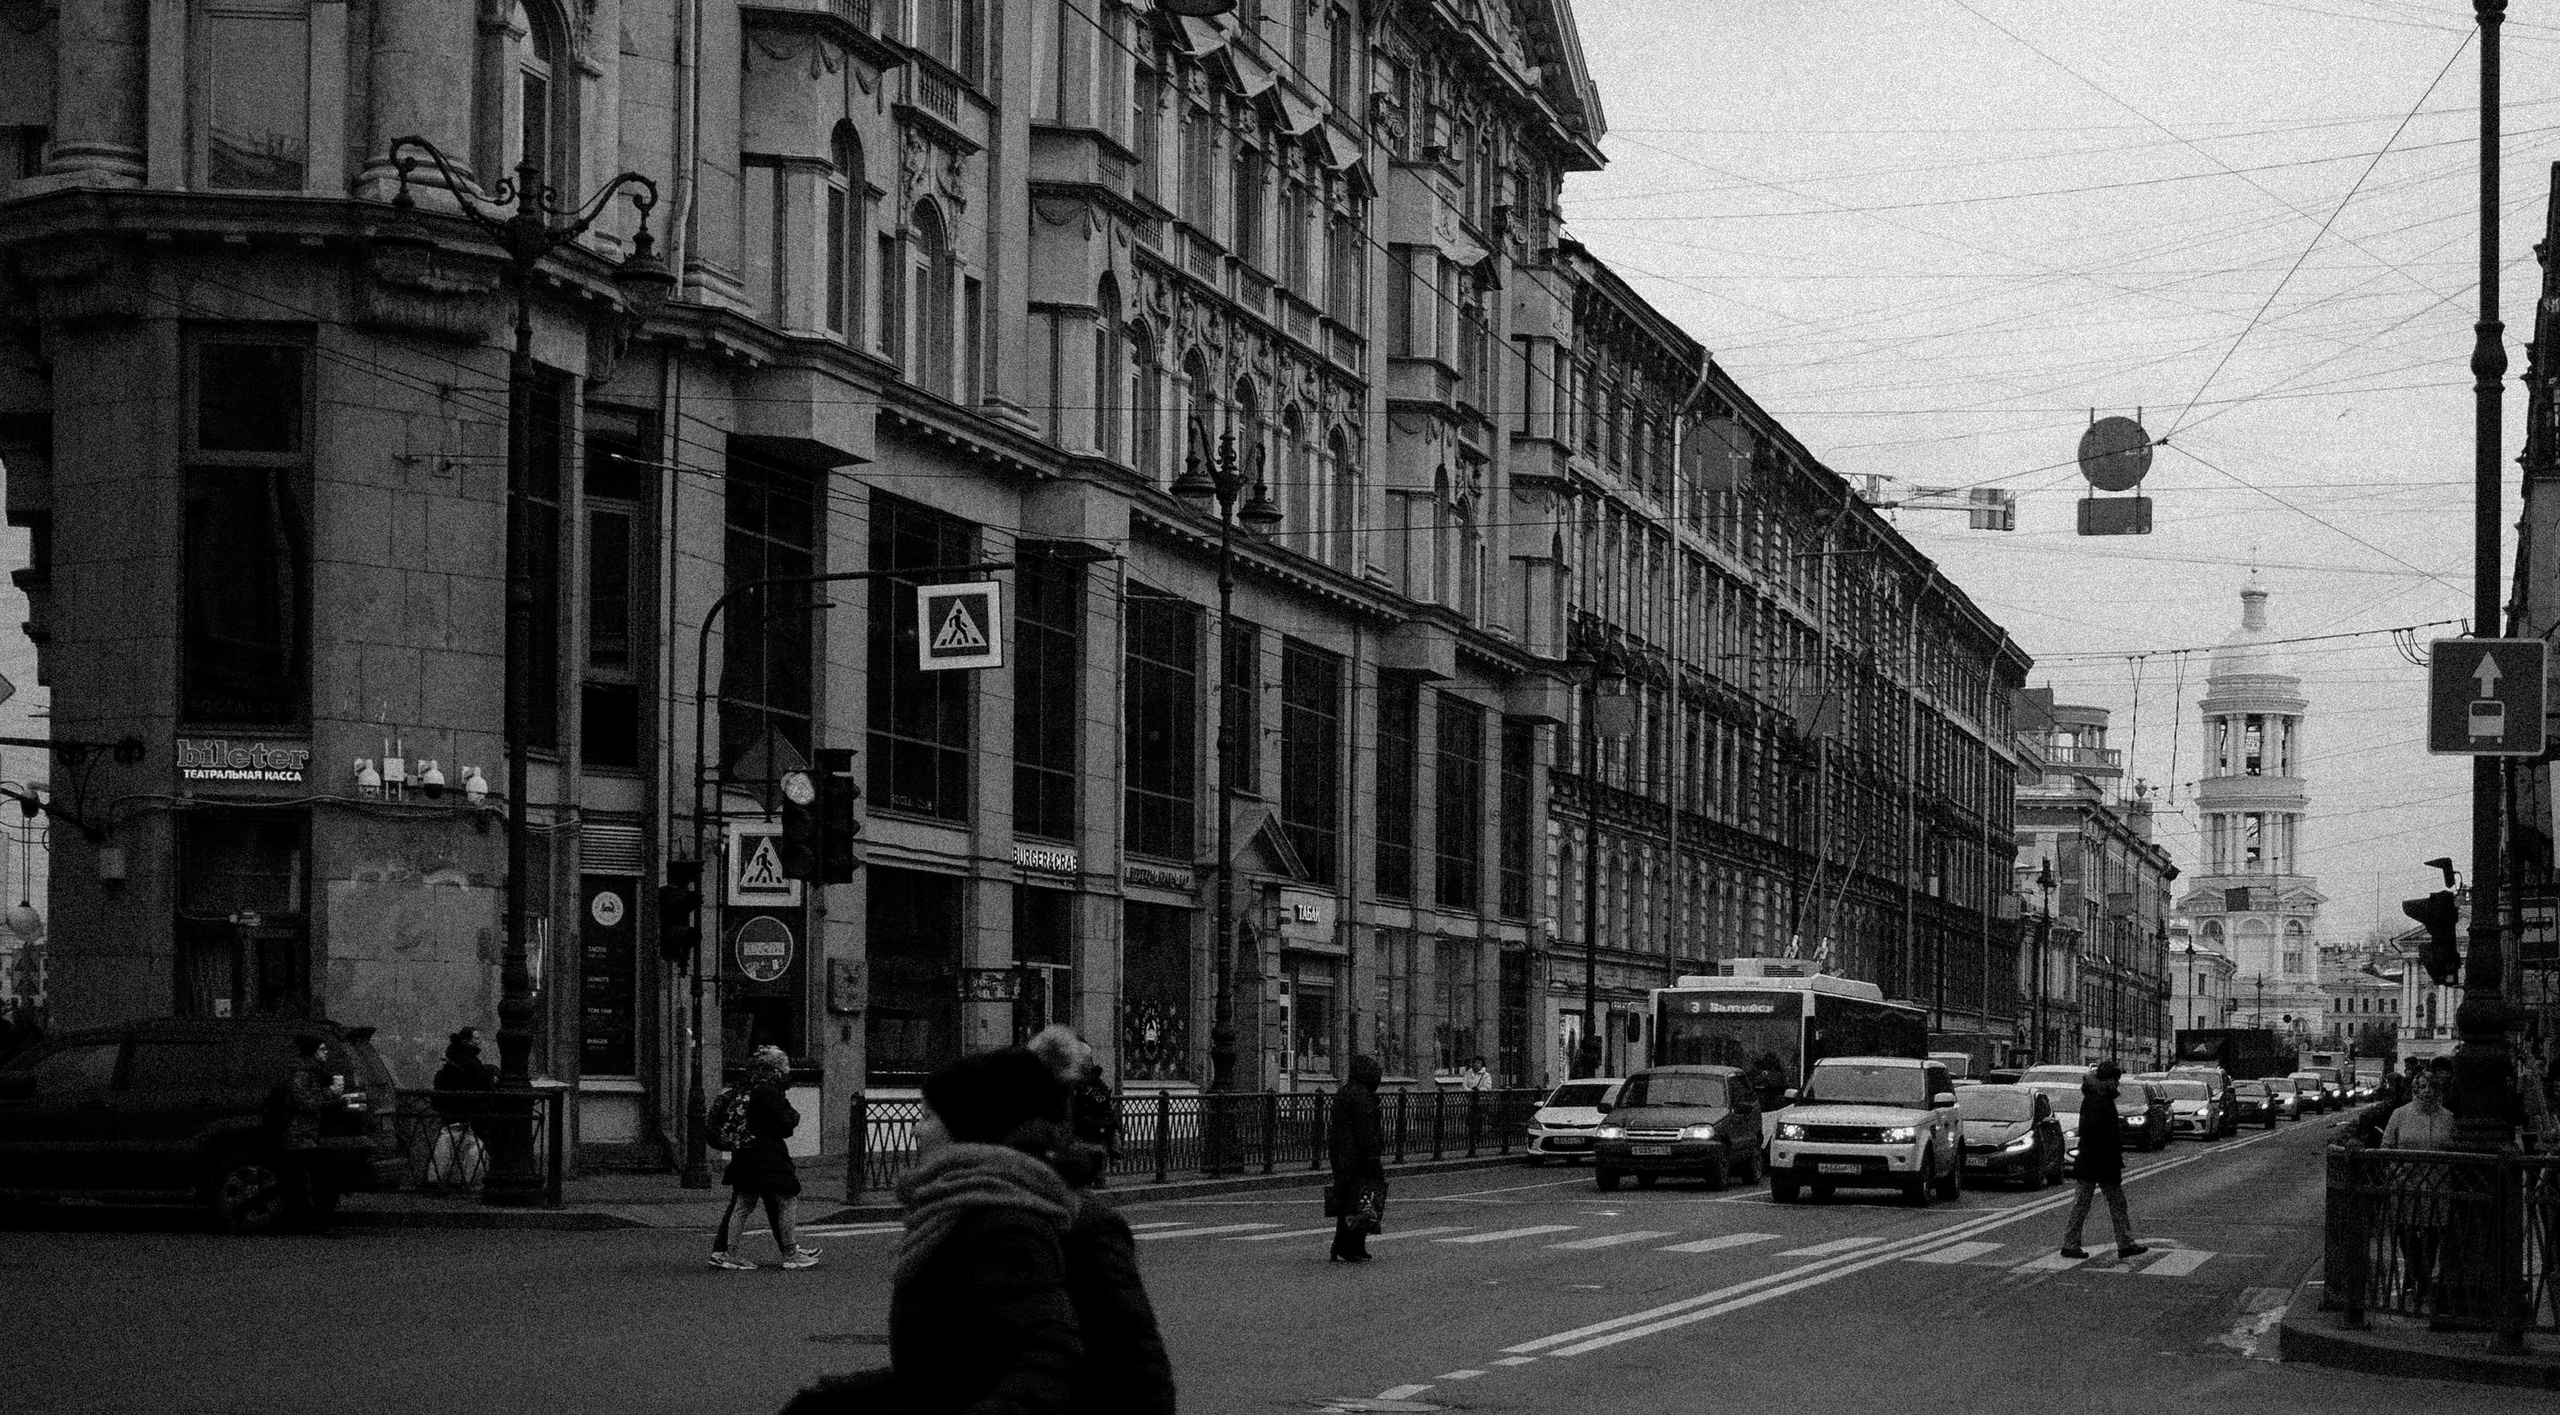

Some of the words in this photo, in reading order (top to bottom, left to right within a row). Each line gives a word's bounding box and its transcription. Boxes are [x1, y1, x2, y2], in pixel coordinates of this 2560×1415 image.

[177, 739, 309, 770] bileter
[183, 769, 262, 781] ТЕАТРАЛЬНАЯ
[264, 770, 302, 782] КАССА
[1012, 847, 1079, 872] BURGER&CRAB
[1297, 904, 1321, 923] ТАБАК
[1690, 1001, 1700, 1014] 3
